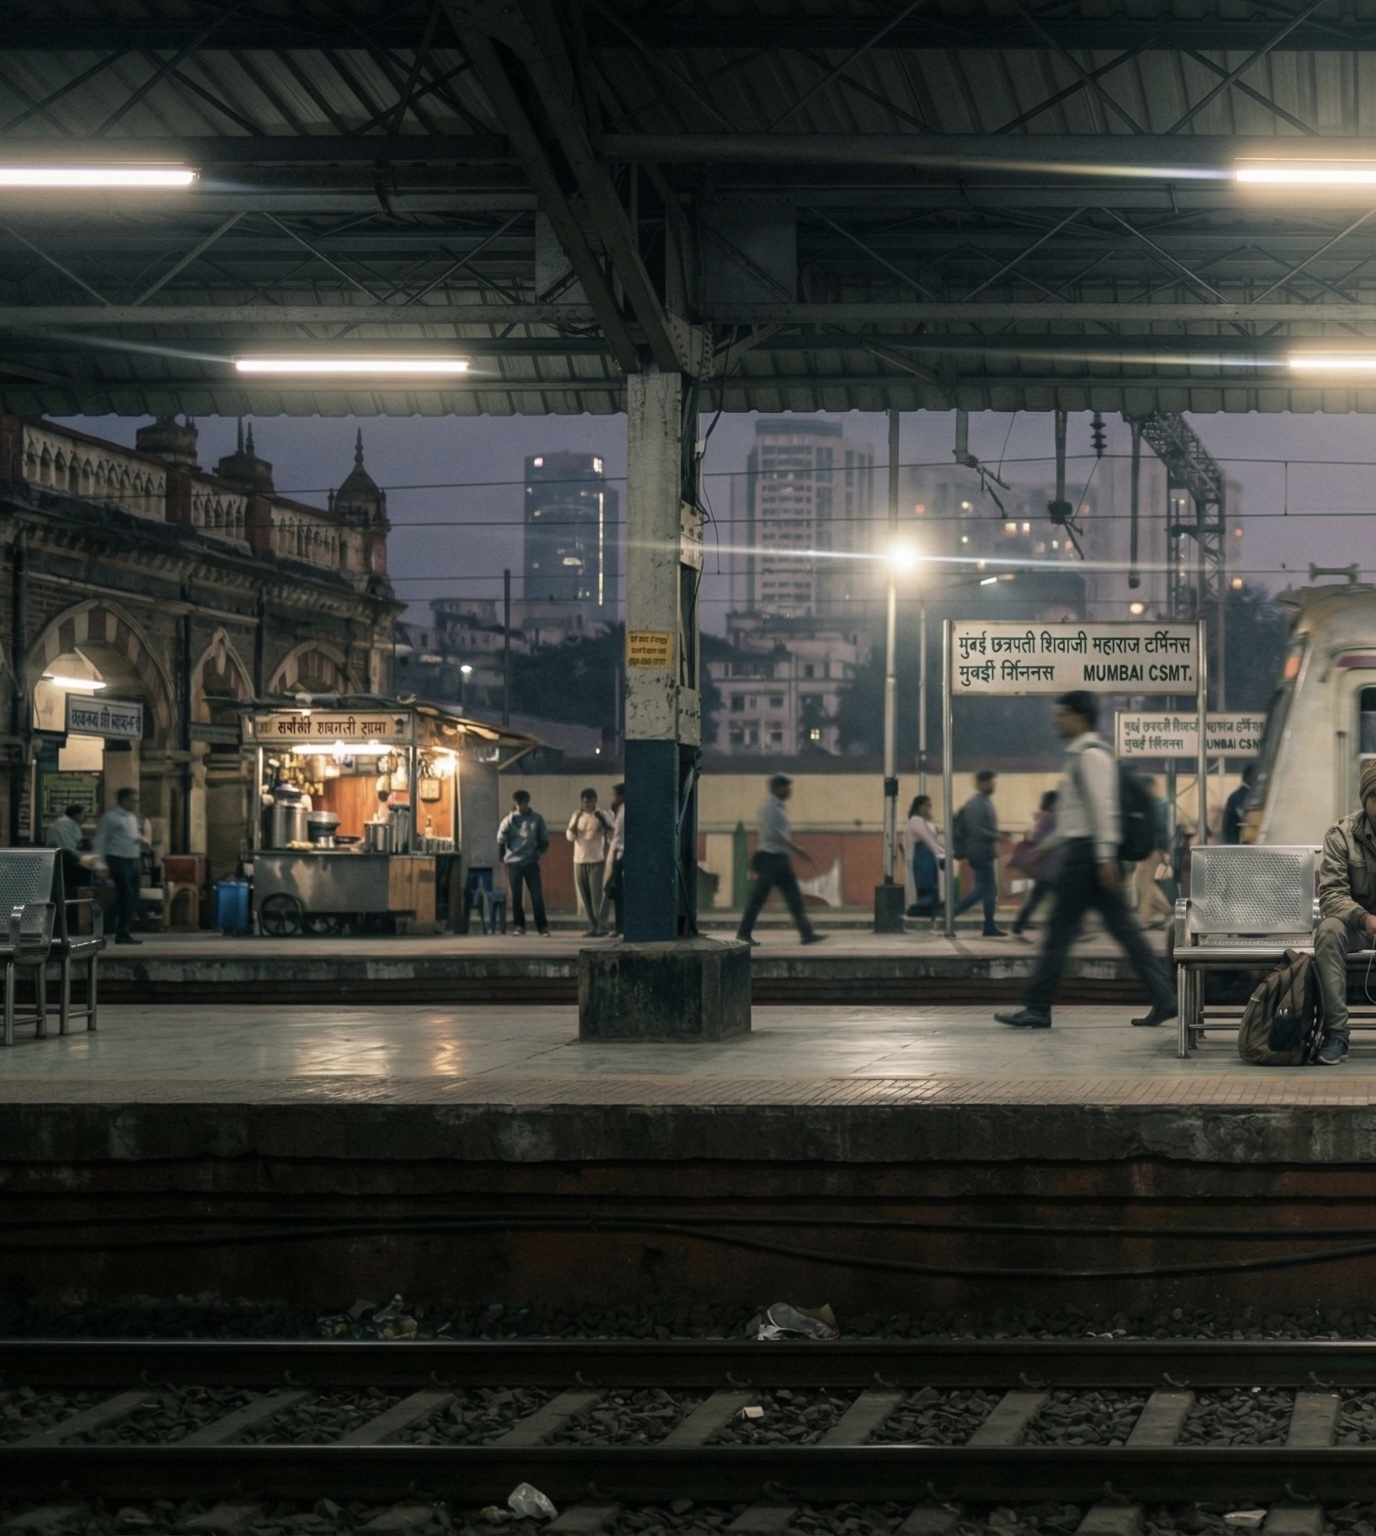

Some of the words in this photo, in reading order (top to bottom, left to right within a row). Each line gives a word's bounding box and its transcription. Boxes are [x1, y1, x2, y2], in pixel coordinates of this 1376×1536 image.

[958, 630, 987, 660] मुंबई
[991, 630, 1036, 653] छत्रपती
[1040, 630, 1088, 654] शिवाजी
[1092, 637, 1141, 656] महाराज
[1083, 664, 1144, 682] MUMBAI
[1148, 664, 1193, 682] CSMT.
